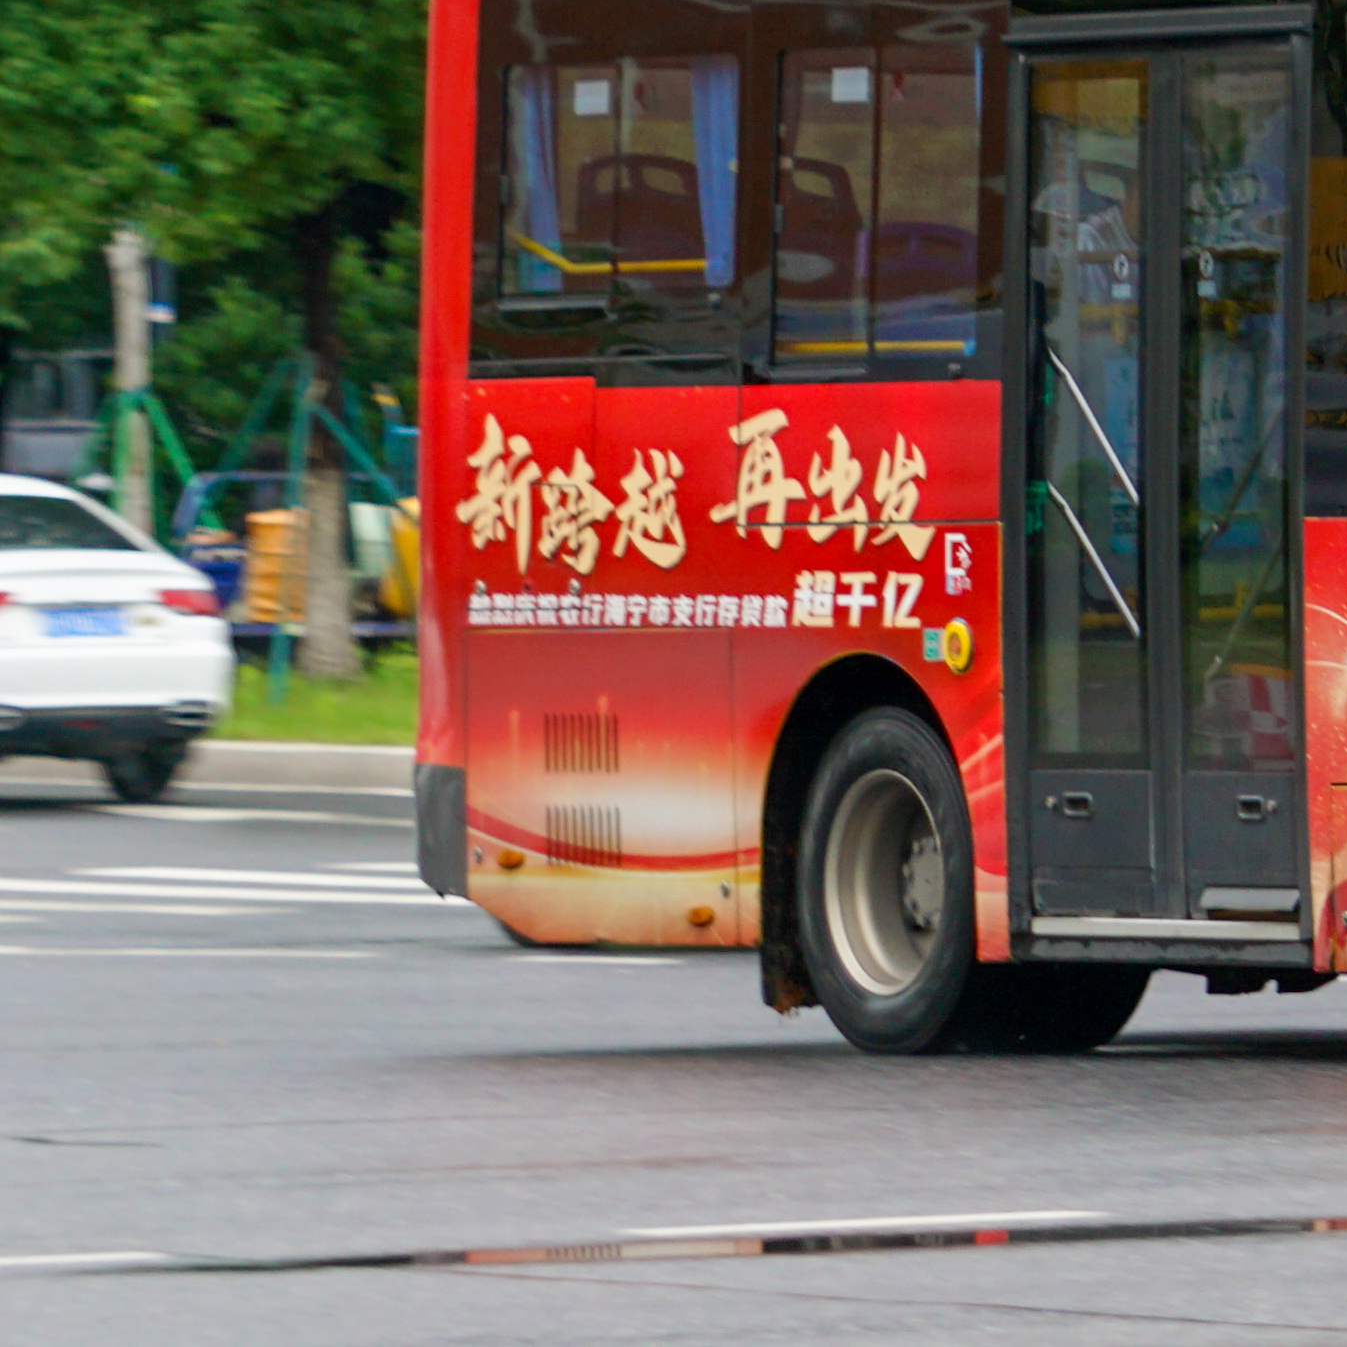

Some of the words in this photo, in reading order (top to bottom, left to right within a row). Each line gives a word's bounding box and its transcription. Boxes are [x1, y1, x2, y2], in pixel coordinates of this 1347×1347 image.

[456, 412, 687, 576] 新跨越
[708, 407, 938, 563] 再出发
[791, 569, 925, 629] 超千亿
